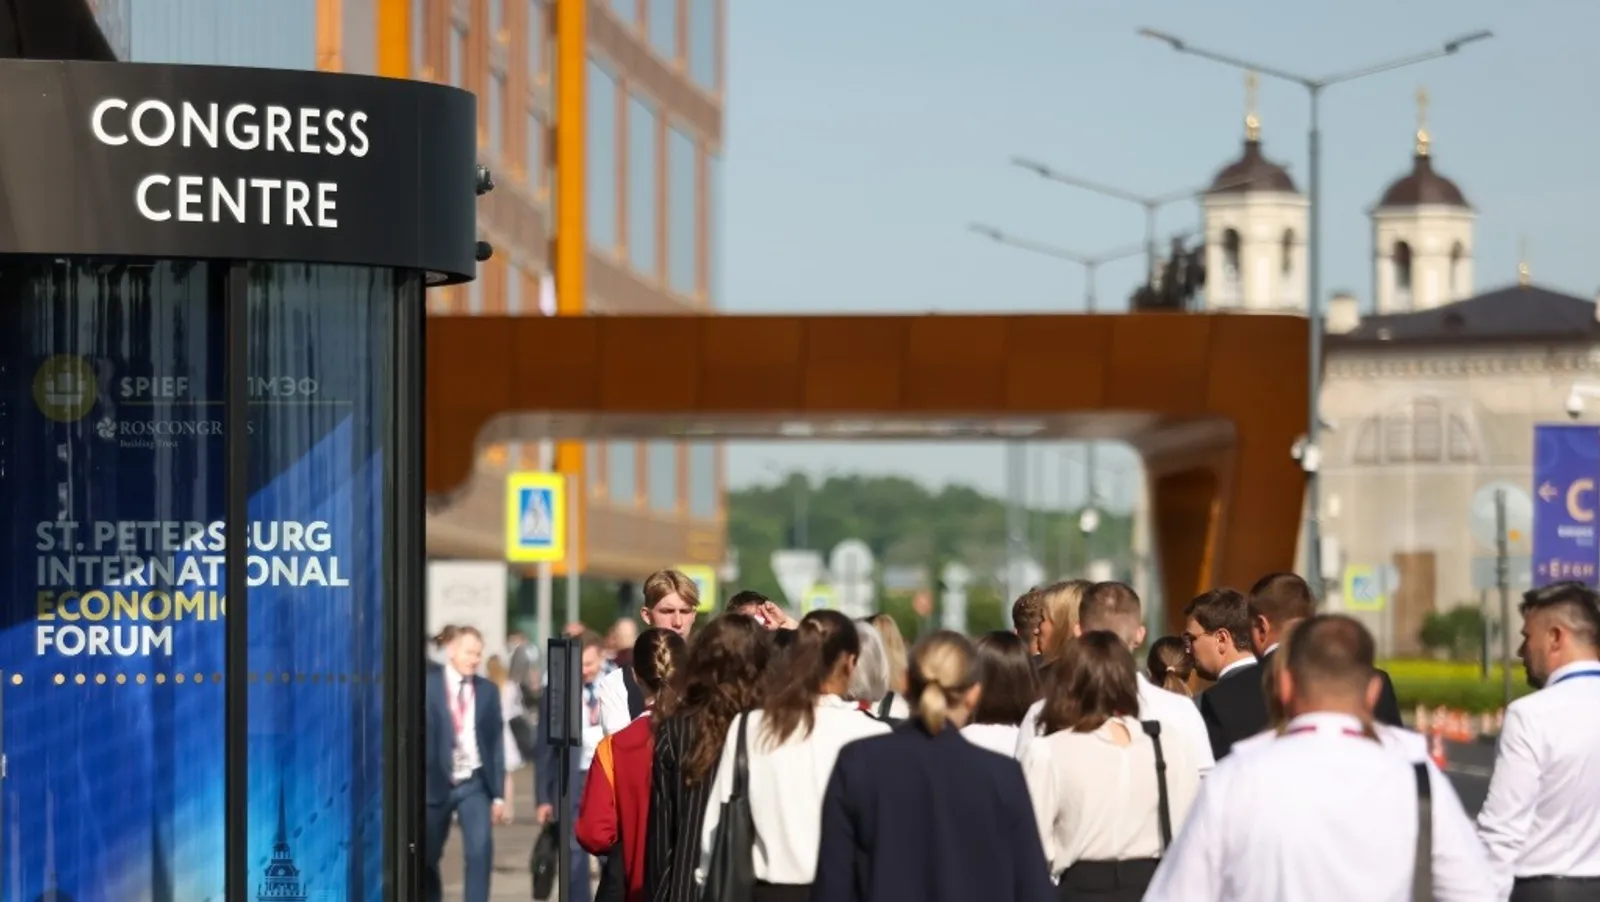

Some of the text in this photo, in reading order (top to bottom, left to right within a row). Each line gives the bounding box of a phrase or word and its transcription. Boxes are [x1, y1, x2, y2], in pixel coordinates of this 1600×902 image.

[92, 98, 369, 157] CONGRESS
[136, 174, 338, 228] CENTRE
[120, 376, 189, 397] SPIEF
[120, 420, 255, 435] ROSCONGRS
[36, 520, 332, 552] ST. PETERSURG
[37, 555, 350, 586] INTERNATONAL
[37, 590, 226, 621] ECONOMI
[37, 625, 173, 656] FORUM
